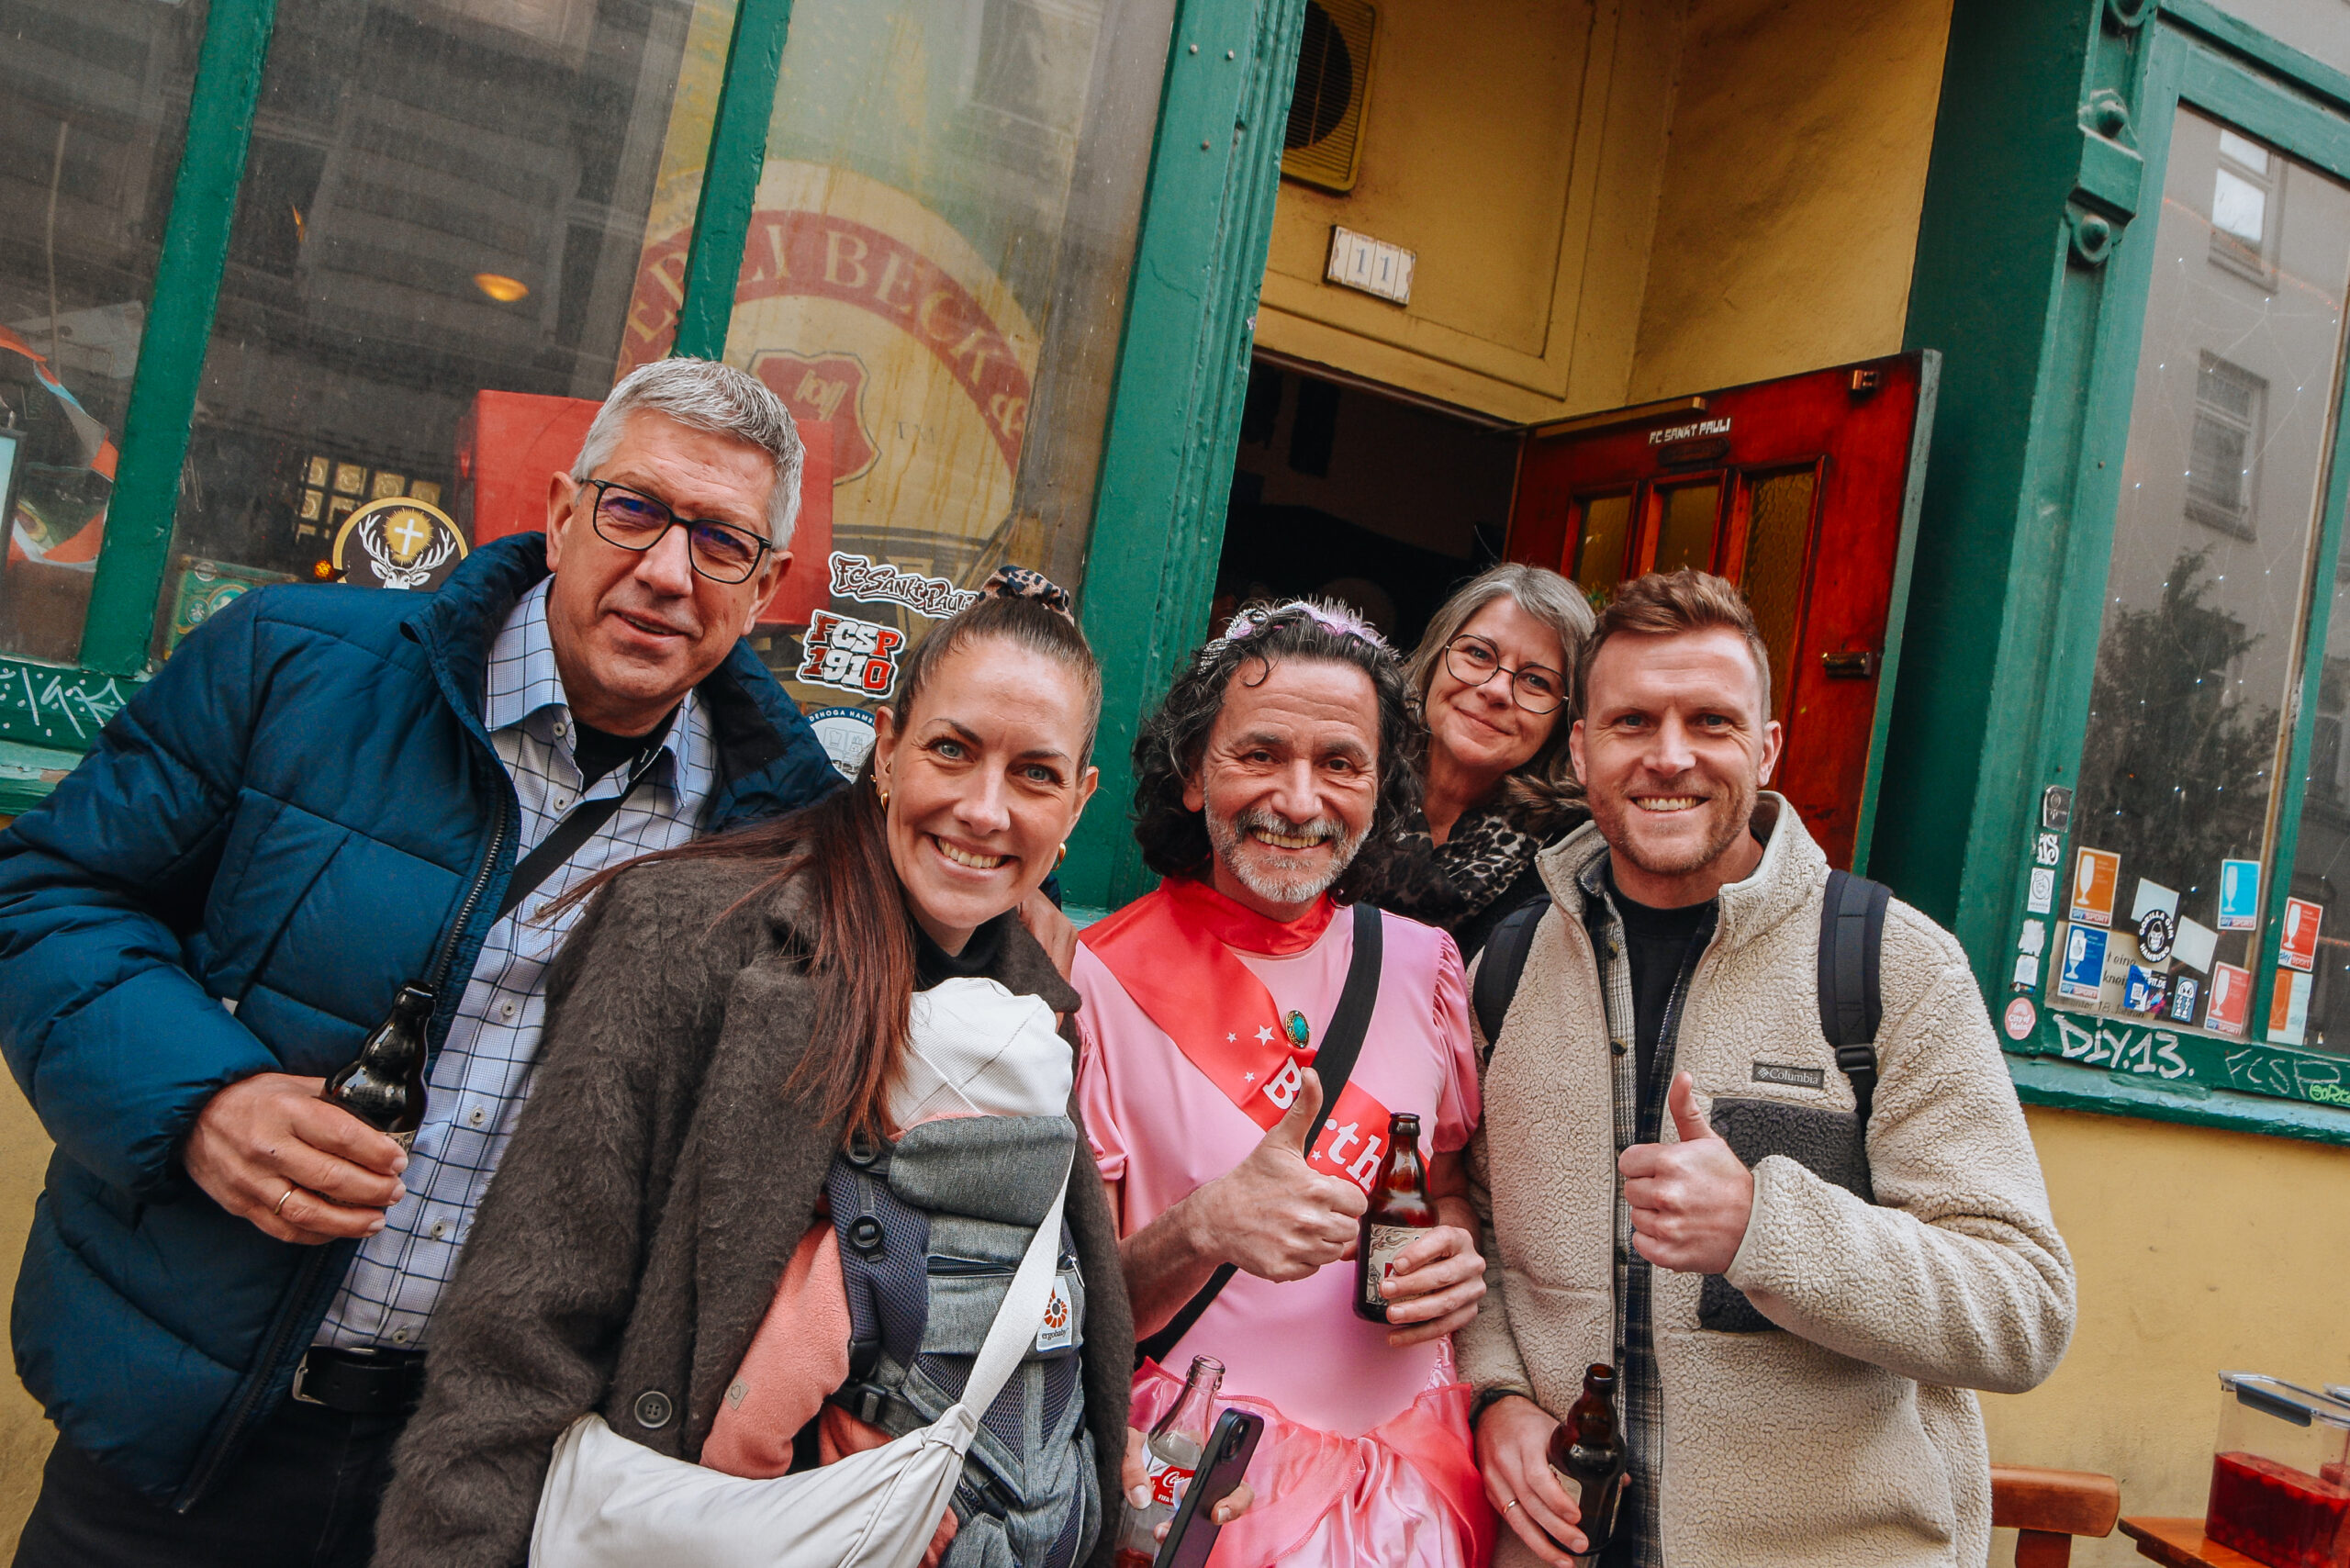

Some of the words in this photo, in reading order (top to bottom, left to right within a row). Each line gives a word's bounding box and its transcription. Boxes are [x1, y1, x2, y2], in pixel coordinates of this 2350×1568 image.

[1356, 248, 1390, 282] 11
[1649, 430, 1662, 444] FC
[1664, 423, 1698, 442] SANKT
[1699, 417, 1731, 436] PAULI
[807, 614, 901, 658] FCSP
[801, 644, 891, 690] 1910
[808, 710, 845, 722] DEHOGA
[849, 711, 875, 726] HAMB
[2139, 911, 2165, 936] GORILLA
[2165, 916, 2175, 939] GYM
[2140, 943, 2170, 962] HAMBURG
[2008, 1014, 2022, 1023] City
[2023, 1014, 2031, 1024] of
[1769, 1069, 1819, 1085] Columbia
[1042, 1329, 1067, 1340] ergobaby
[1158, 1494, 1170, 1503] FIFA
